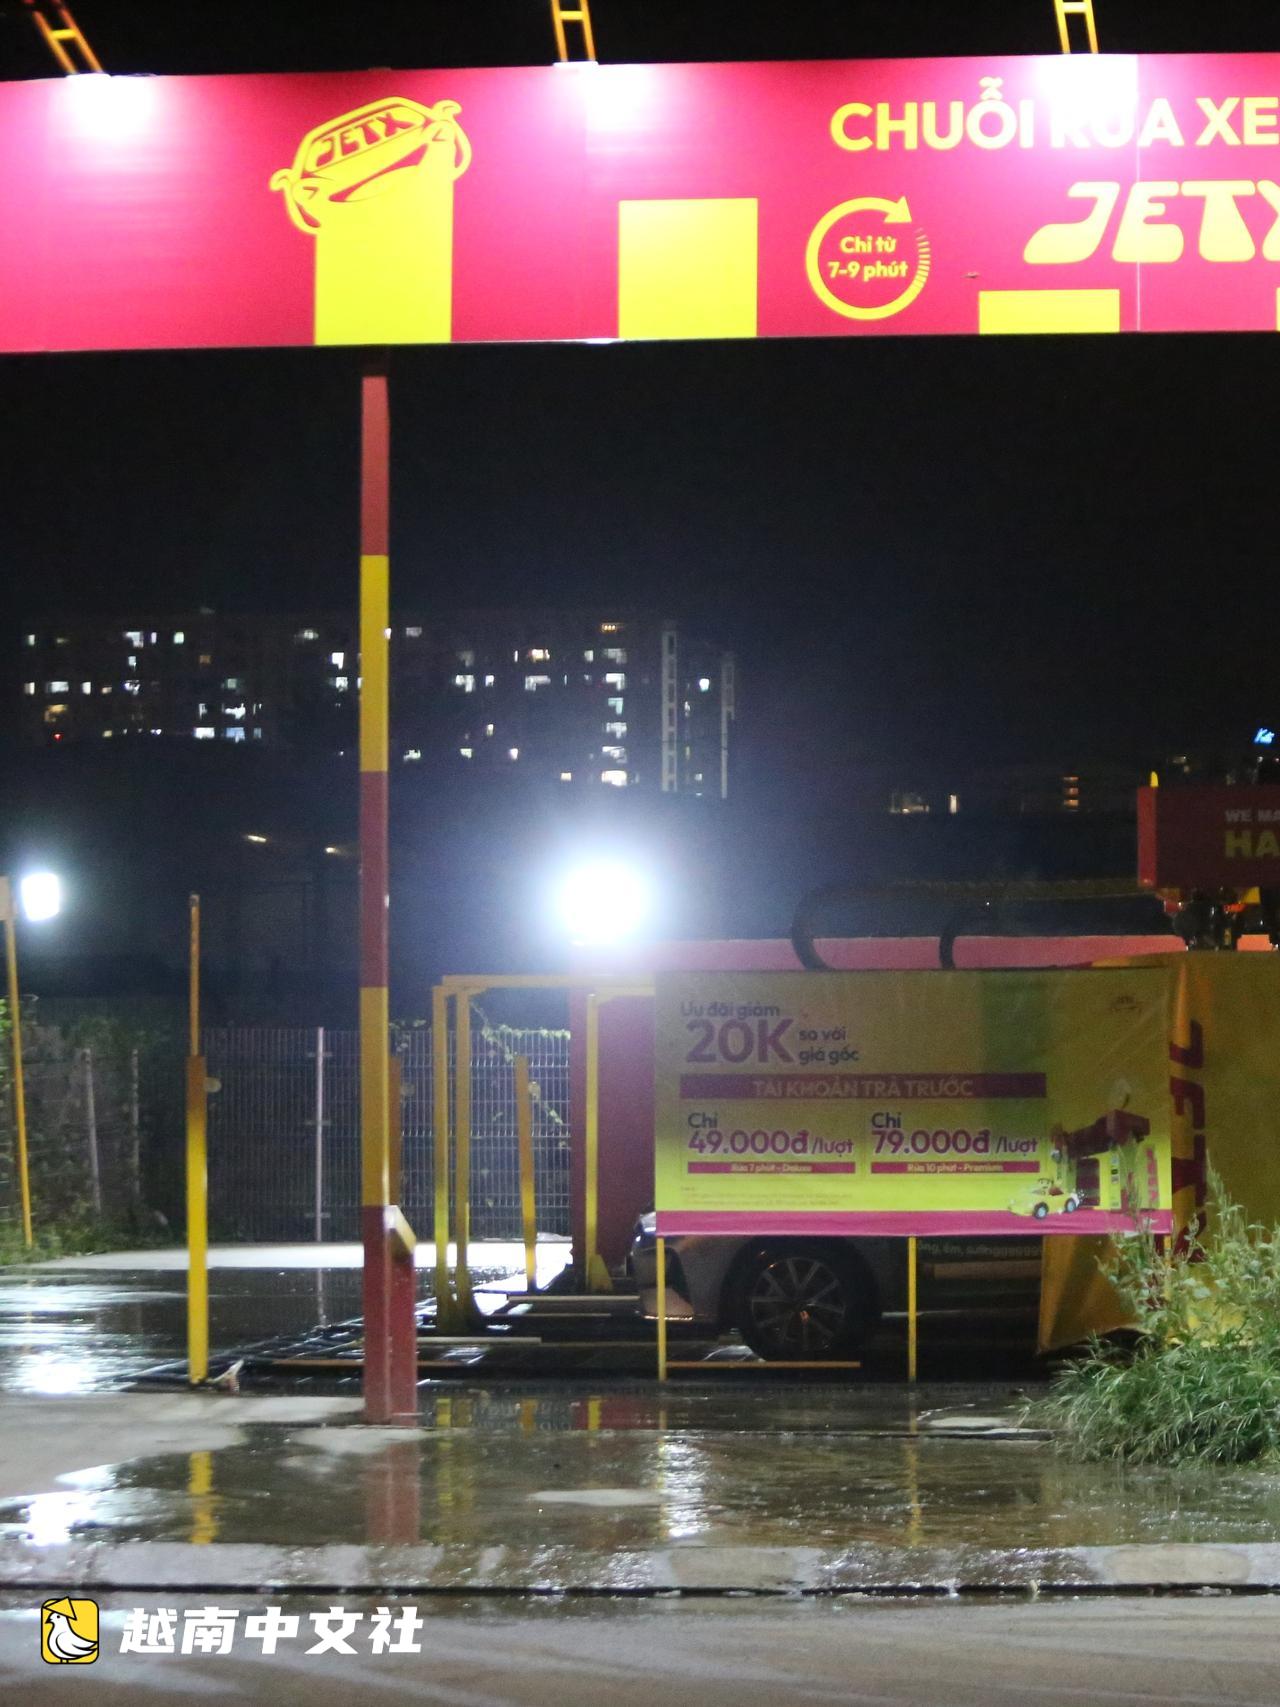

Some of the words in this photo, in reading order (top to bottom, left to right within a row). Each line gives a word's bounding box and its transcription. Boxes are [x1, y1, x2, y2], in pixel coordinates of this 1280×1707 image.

[830, 76, 1033, 151] CHUỖI
[1195, 96, 1280, 146] XE
[315, 110, 416, 166] JETX
[828, 260, 861, 279] 7-9
[863, 258, 909, 282] phút
[1225, 808, 1252, 823] WE
[685, 1018, 795, 1064] 20K
[799, 1028, 818, 1041] so
[821, 1025, 847, 1041] với
[798, 1047, 826, 1066] giá
[828, 1045, 859, 1066] gốc
[785, 1074, 859, 1097] KHOẢN
[688, 1129, 810, 1155] 49.000đ
[811, 1136, 854, 1157] /lượt
[871, 1128, 991, 1154] 79.000đ
[995, 1136, 1038, 1156] /lượt
